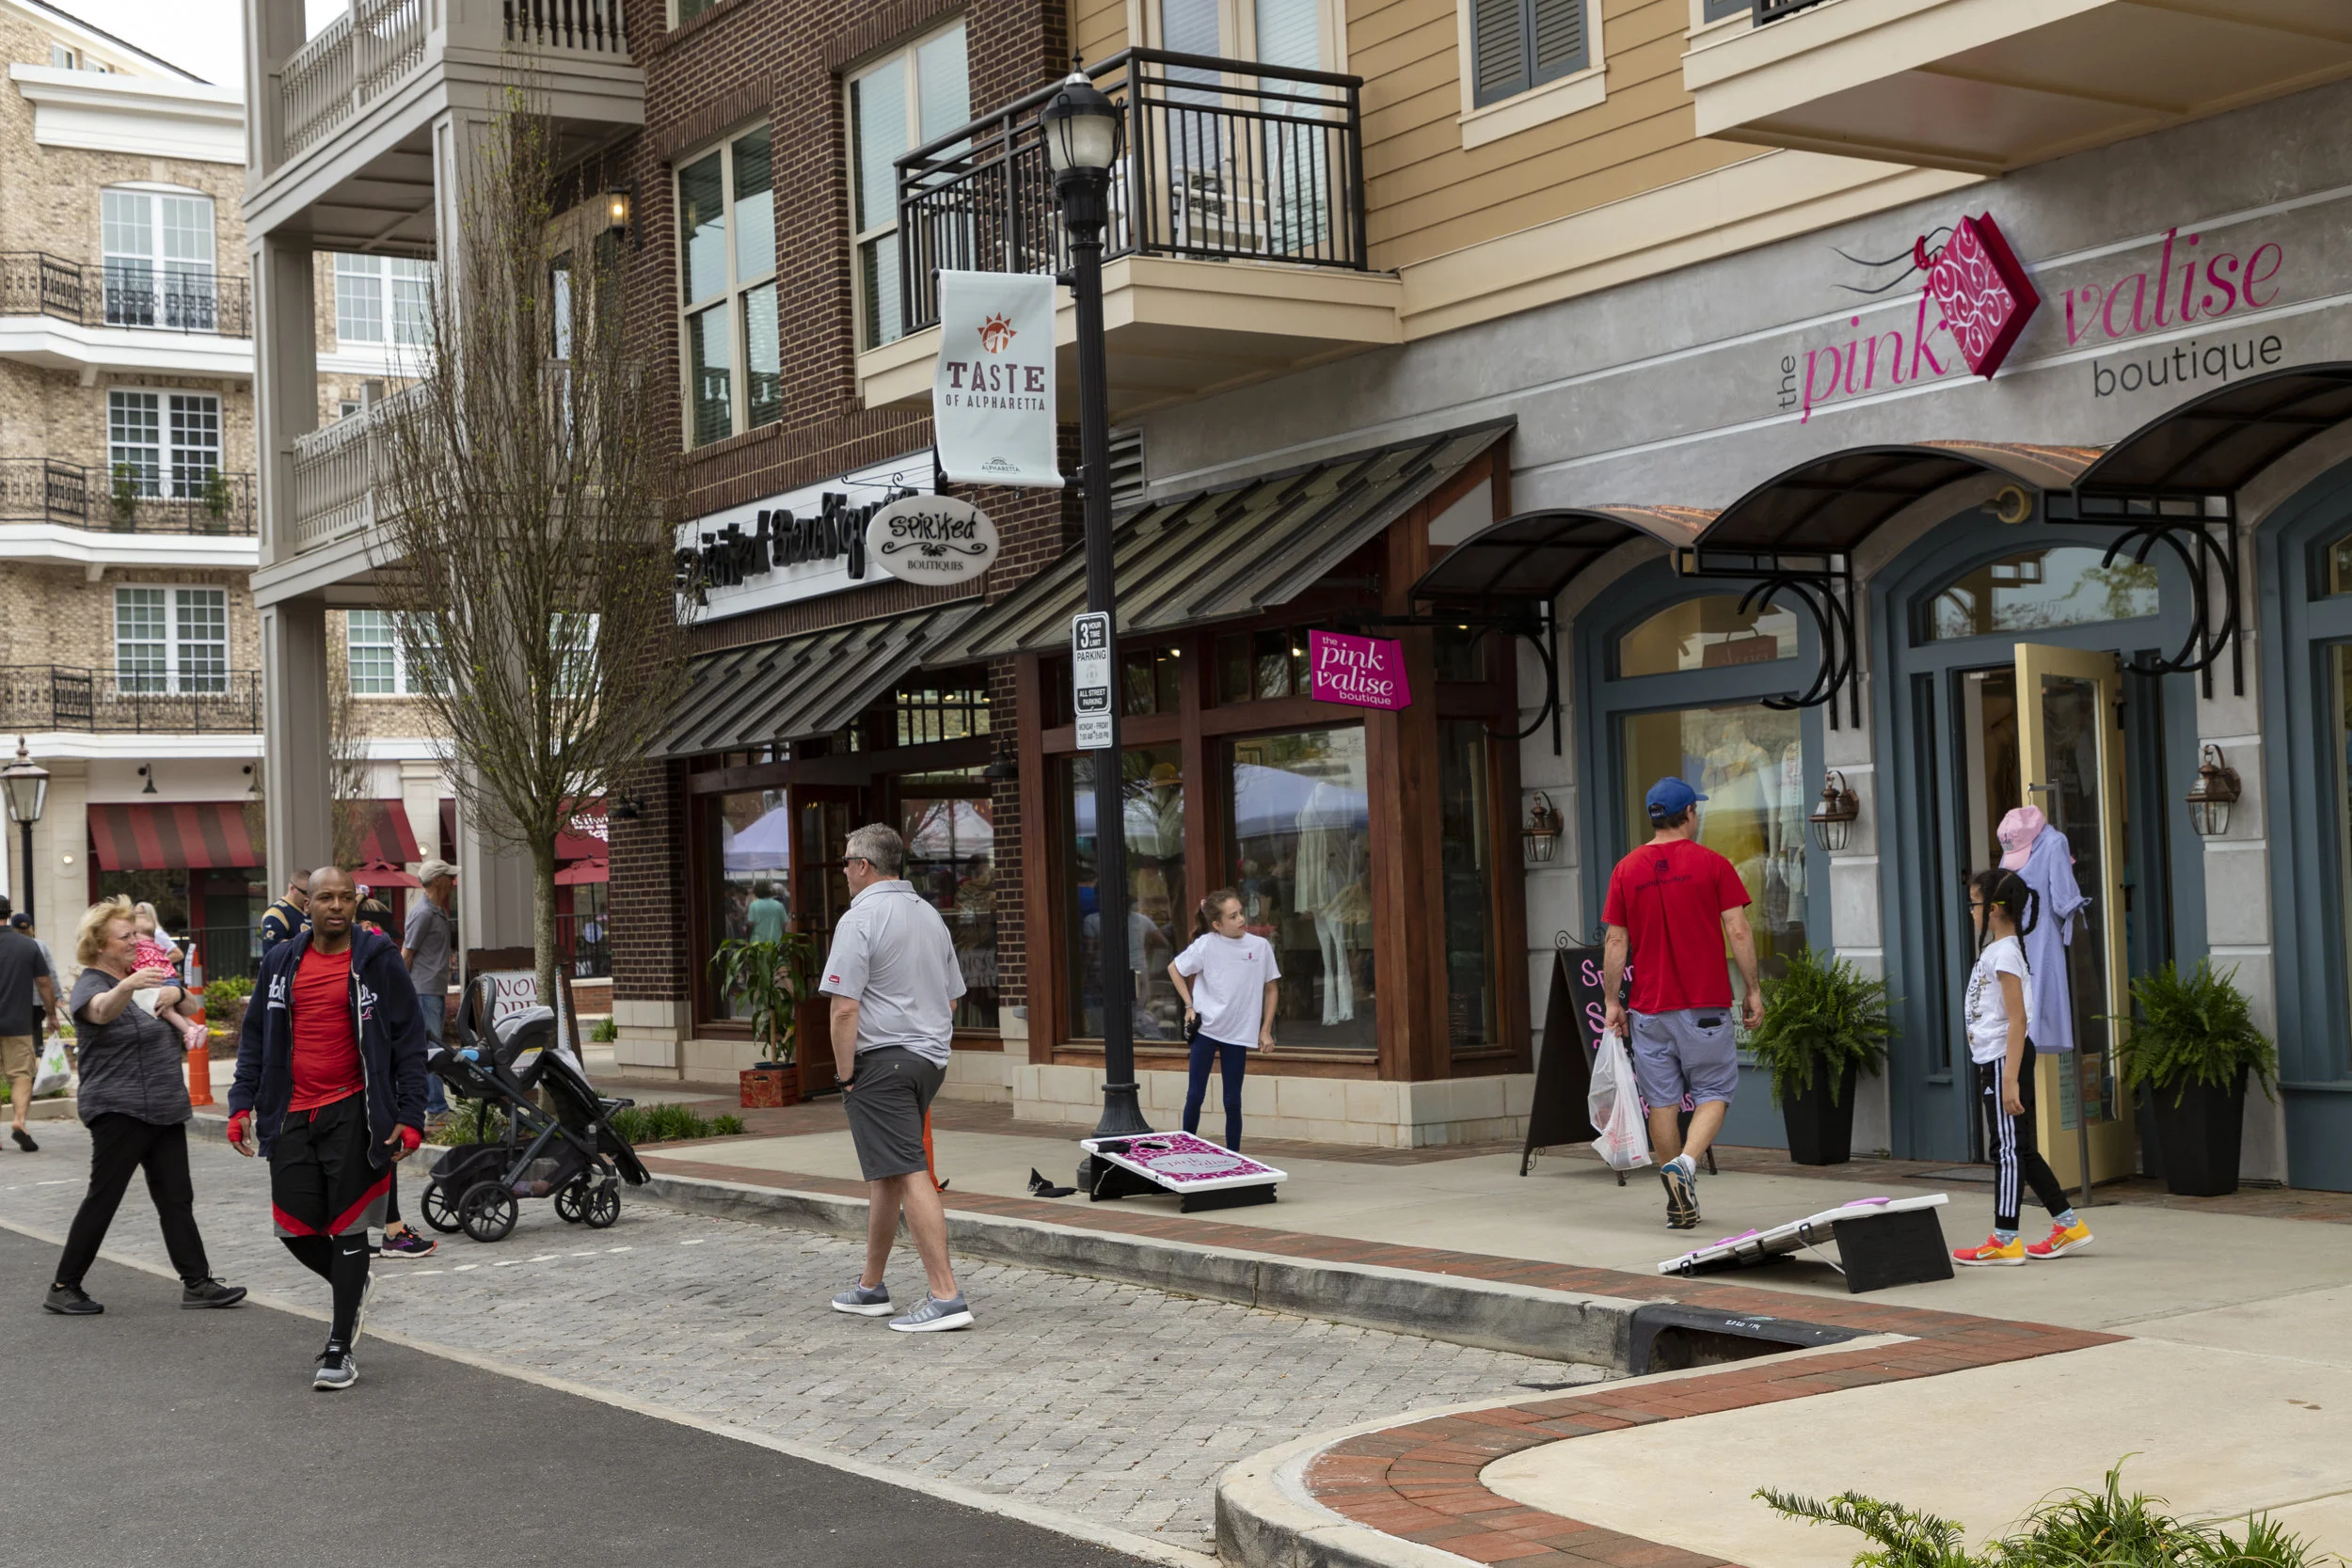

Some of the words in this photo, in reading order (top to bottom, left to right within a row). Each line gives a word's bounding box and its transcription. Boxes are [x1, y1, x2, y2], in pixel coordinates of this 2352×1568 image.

[1778, 355, 1796, 408] the
[1800, 284, 1951, 424] pink
[2058, 227, 2283, 347] valise
[2093, 334, 2283, 399] boutique
[946, 361, 1045, 393] TASTE
[946, 394, 960, 406] OF
[967, 395, 1045, 411] ALPHARETTA
[907, 559, 963, 572] BOUTIQUES
[1089, 621, 1102, 629] HOUR
[1081, 623, 1089, 649] 3
[1089, 639, 1101, 647] LIMIT
[1322, 636, 1338, 645] the
[1076, 650, 1106, 662] PARKING
[1320, 641, 1385, 671] pink
[1315, 666, 1393, 696] valise
[1089, 688, 1105, 696] STREET
[1339, 690, 1391, 705] boutique
[1083, 697, 1103, 706] PARKING
[497, 977, 537, 997] NO
